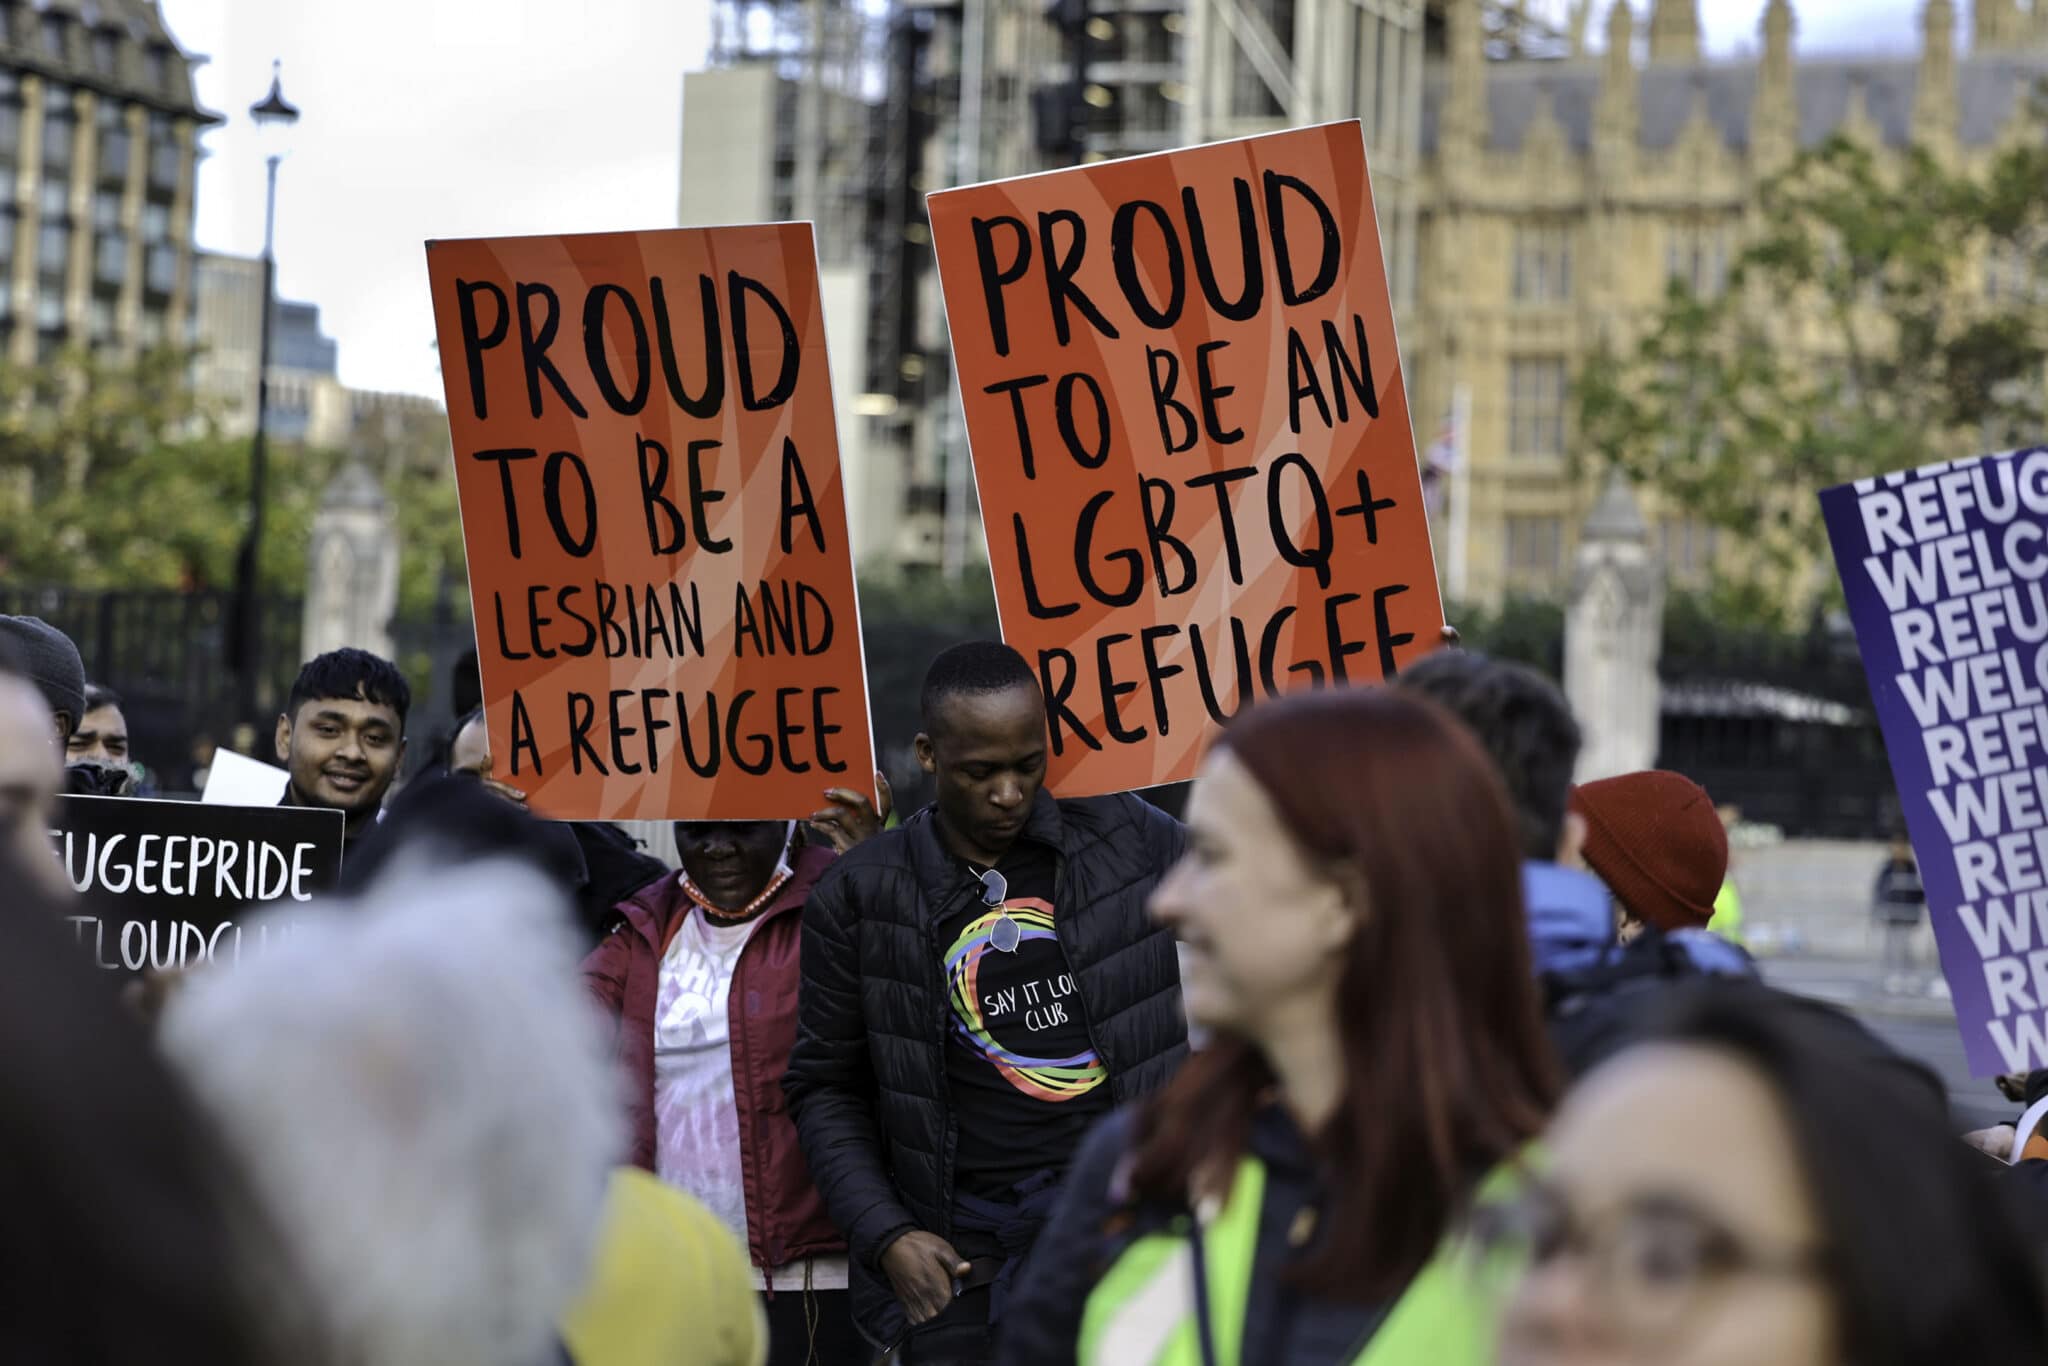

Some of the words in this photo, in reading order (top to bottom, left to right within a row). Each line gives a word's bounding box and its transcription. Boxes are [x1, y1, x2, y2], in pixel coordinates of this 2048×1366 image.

[971, 169, 1341, 357] PROUD
[455, 270, 800, 420] PROUD
[983, 371, 1111, 480] TO
[1146, 341, 1244, 455] BE
[1288, 314, 1379, 434] AN
[472, 448, 597, 559] TO
[635, 432, 733, 555] BE
[780, 435, 826, 553] A
[1013, 453, 1397, 619] LGBTQ+
[495, 578, 705, 660] LESBIAN
[734, 580, 834, 657] AND
[1038, 584, 1415, 757] REFUGEE
[1890, 581, 2048, 671] REFU
[510, 689, 542, 777] A
[567, 686, 848, 778] REFUGEE
[984, 986, 1016, 1016] SAY
[1022, 981, 1040, 1005] IT
[1025, 1002, 1068, 1031] CLUB
